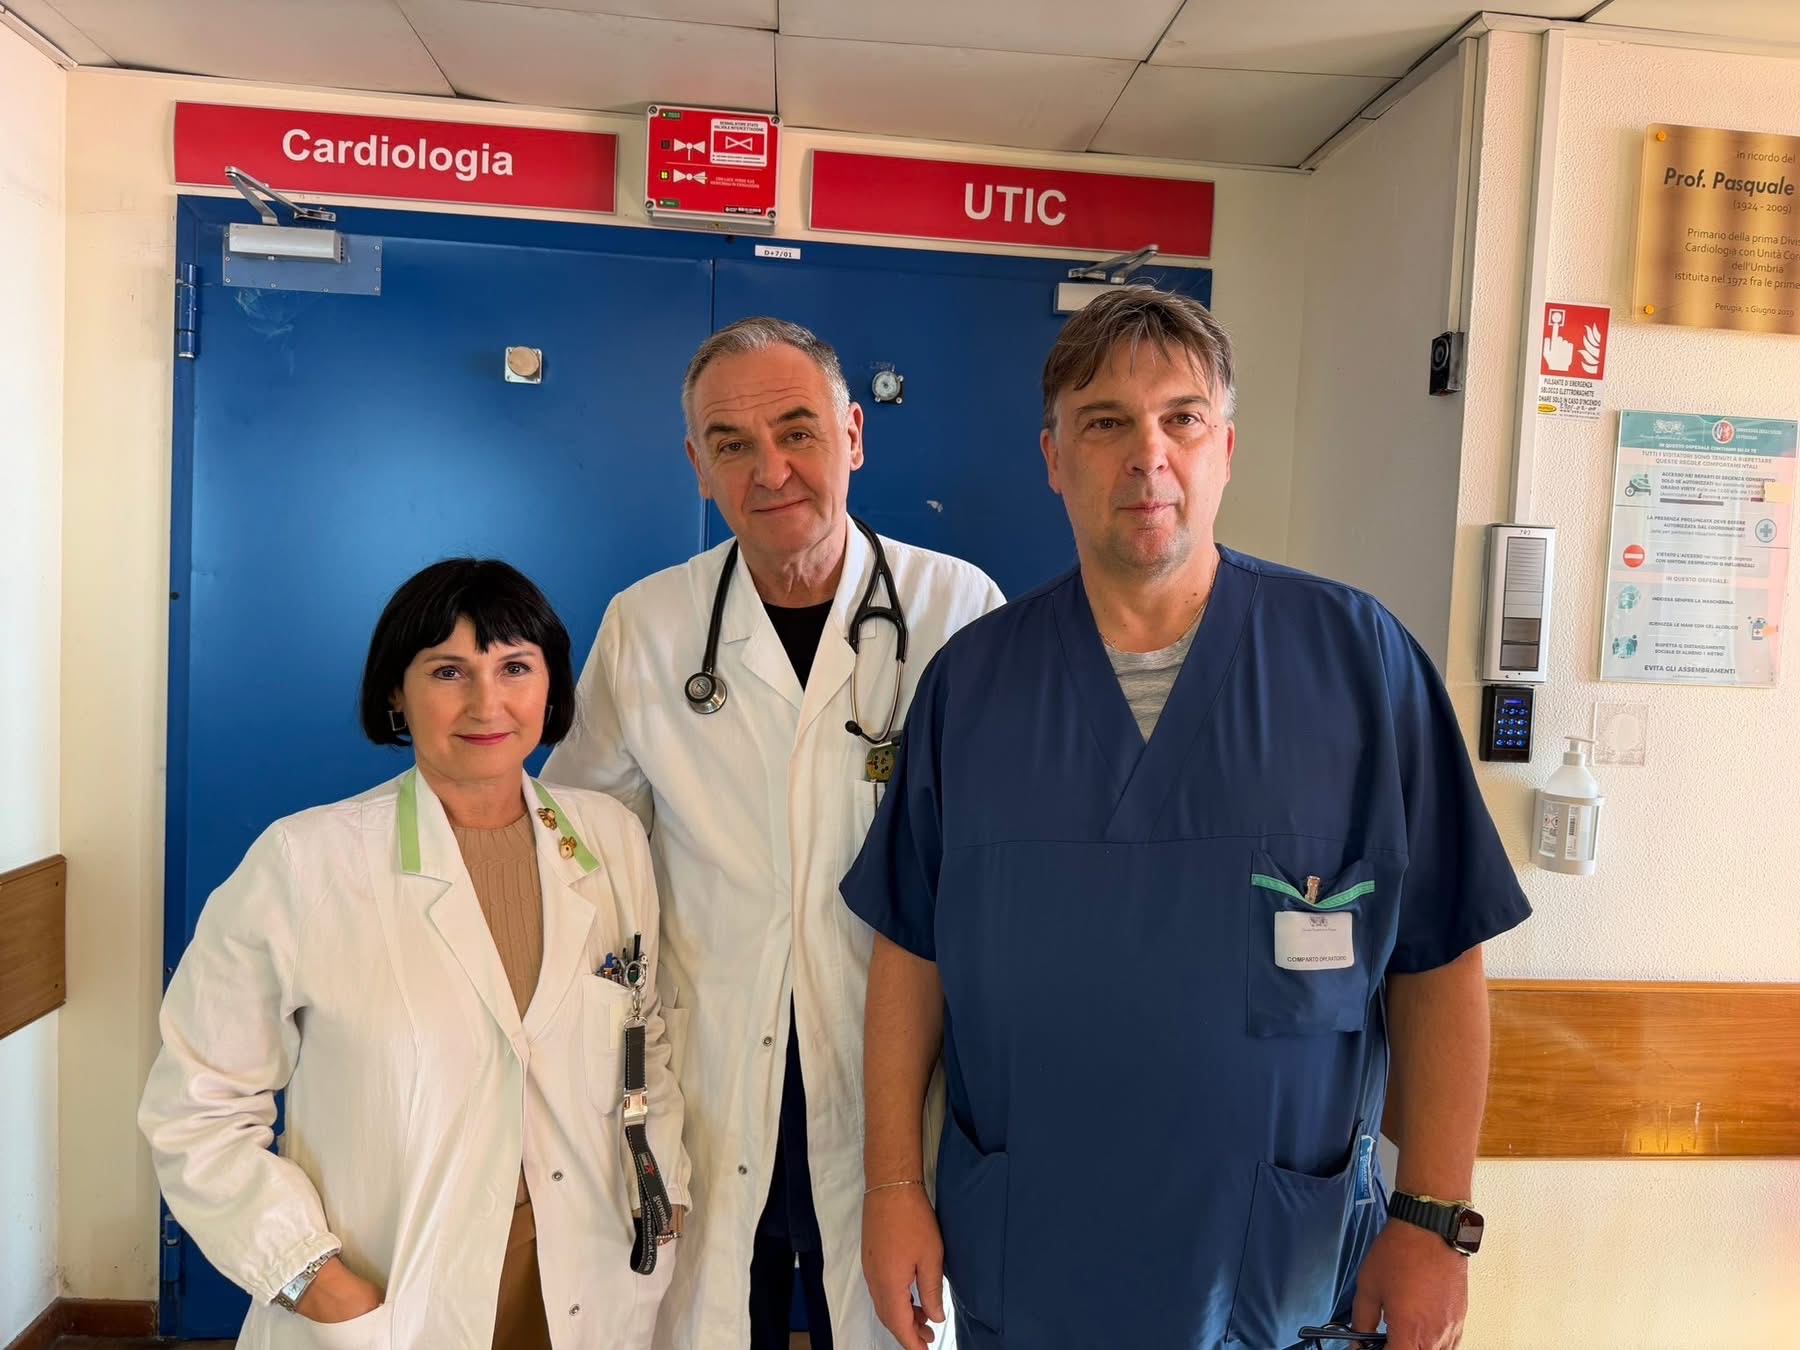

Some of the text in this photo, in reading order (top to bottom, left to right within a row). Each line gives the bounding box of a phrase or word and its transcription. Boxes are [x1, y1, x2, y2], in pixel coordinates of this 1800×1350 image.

[281, 128, 514, 182] Cardiologia
[1736, 151, 1796, 164] in ricordo del
[1664, 167, 1795, 197] Prof. Pasquale
[964, 182, 1067, 226] UTIC
[1732, 200, 1758, 212] (1924
[1766, 204, 1792, 215] 2009)
[1687, 228, 1727, 240] Primario
[1728, 232, 1750, 242] della
[1752, 234, 1778, 244] prima
[764, 250, 792, 258] D+7/01
[1684, 242, 1737, 257] Cardiologia
[1738, 249, 1756, 257] con
[1757, 248, 1781, 259] Unità
[1731, 262, 1784, 274] dell'Umbria
[1674, 272, 1710, 282] istituita
[1711, 274, 1726, 284] nel
[1727, 277, 1748, 287] 1972
[1750, 276, 1763, 286] fra
[1764, 278, 1772, 287] le
[1715, 302, 1744, 314] Perugia,
[1750, 306, 1776, 315] Giugno
